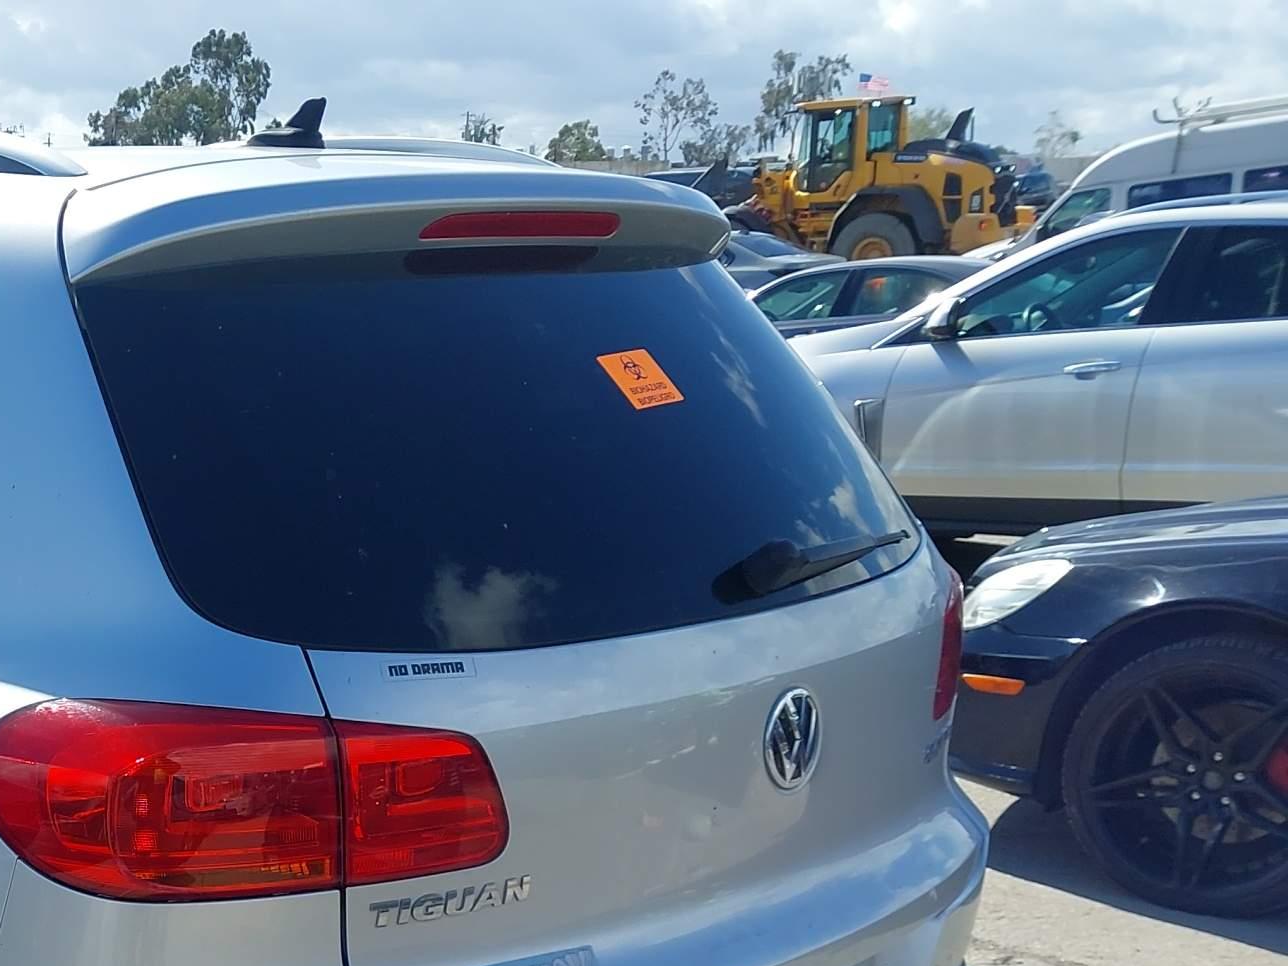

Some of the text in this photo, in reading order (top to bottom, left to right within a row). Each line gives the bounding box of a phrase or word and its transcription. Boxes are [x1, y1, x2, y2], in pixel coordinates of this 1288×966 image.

[387, 661, 466, 677] NO DRAMA
[369, 874, 532, 928] TIGUAN
